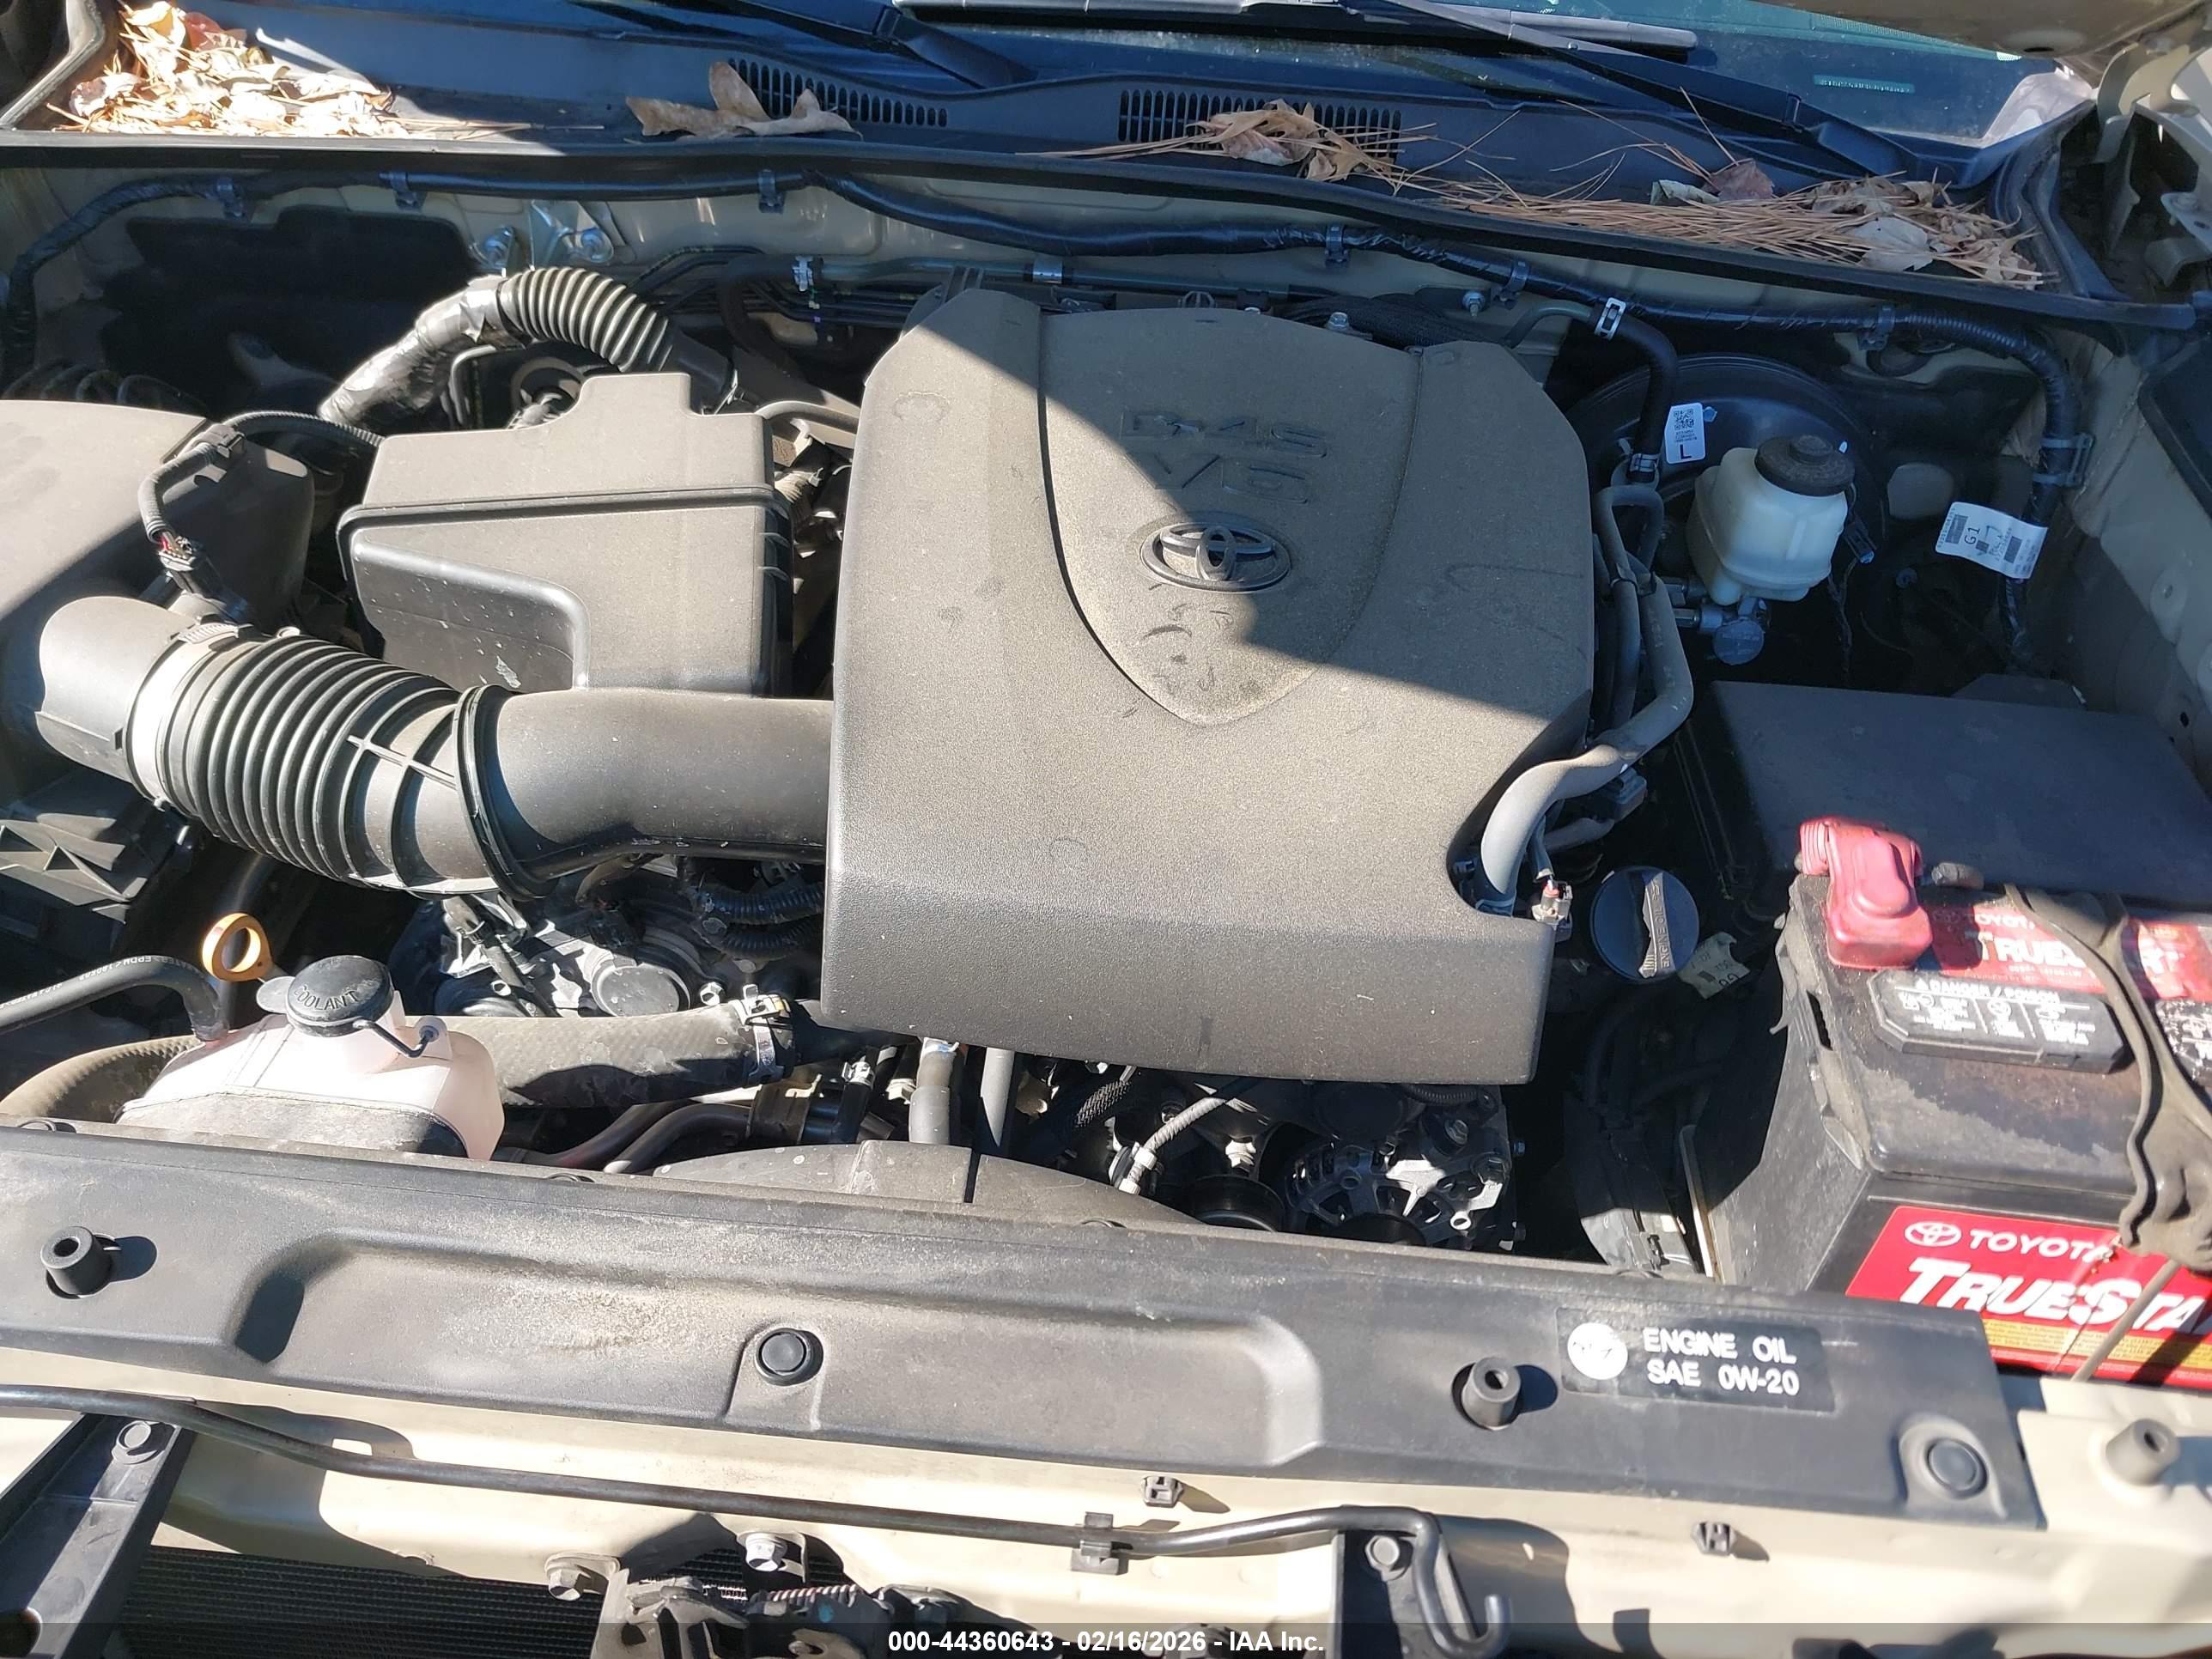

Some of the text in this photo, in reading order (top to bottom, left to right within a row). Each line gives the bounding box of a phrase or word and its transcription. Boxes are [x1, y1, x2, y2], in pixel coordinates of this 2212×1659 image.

[1680, 444, 1692, 459] L
[1965, 526, 1981, 545] G1
[1655, 906, 1671, 969] ENGINE OIL
[295, 983, 359, 1011] COOLANT
[1643, 1327, 1797, 1364] ENGINE OIL
[1646, 1359, 1800, 1396] SAE 0W-20
